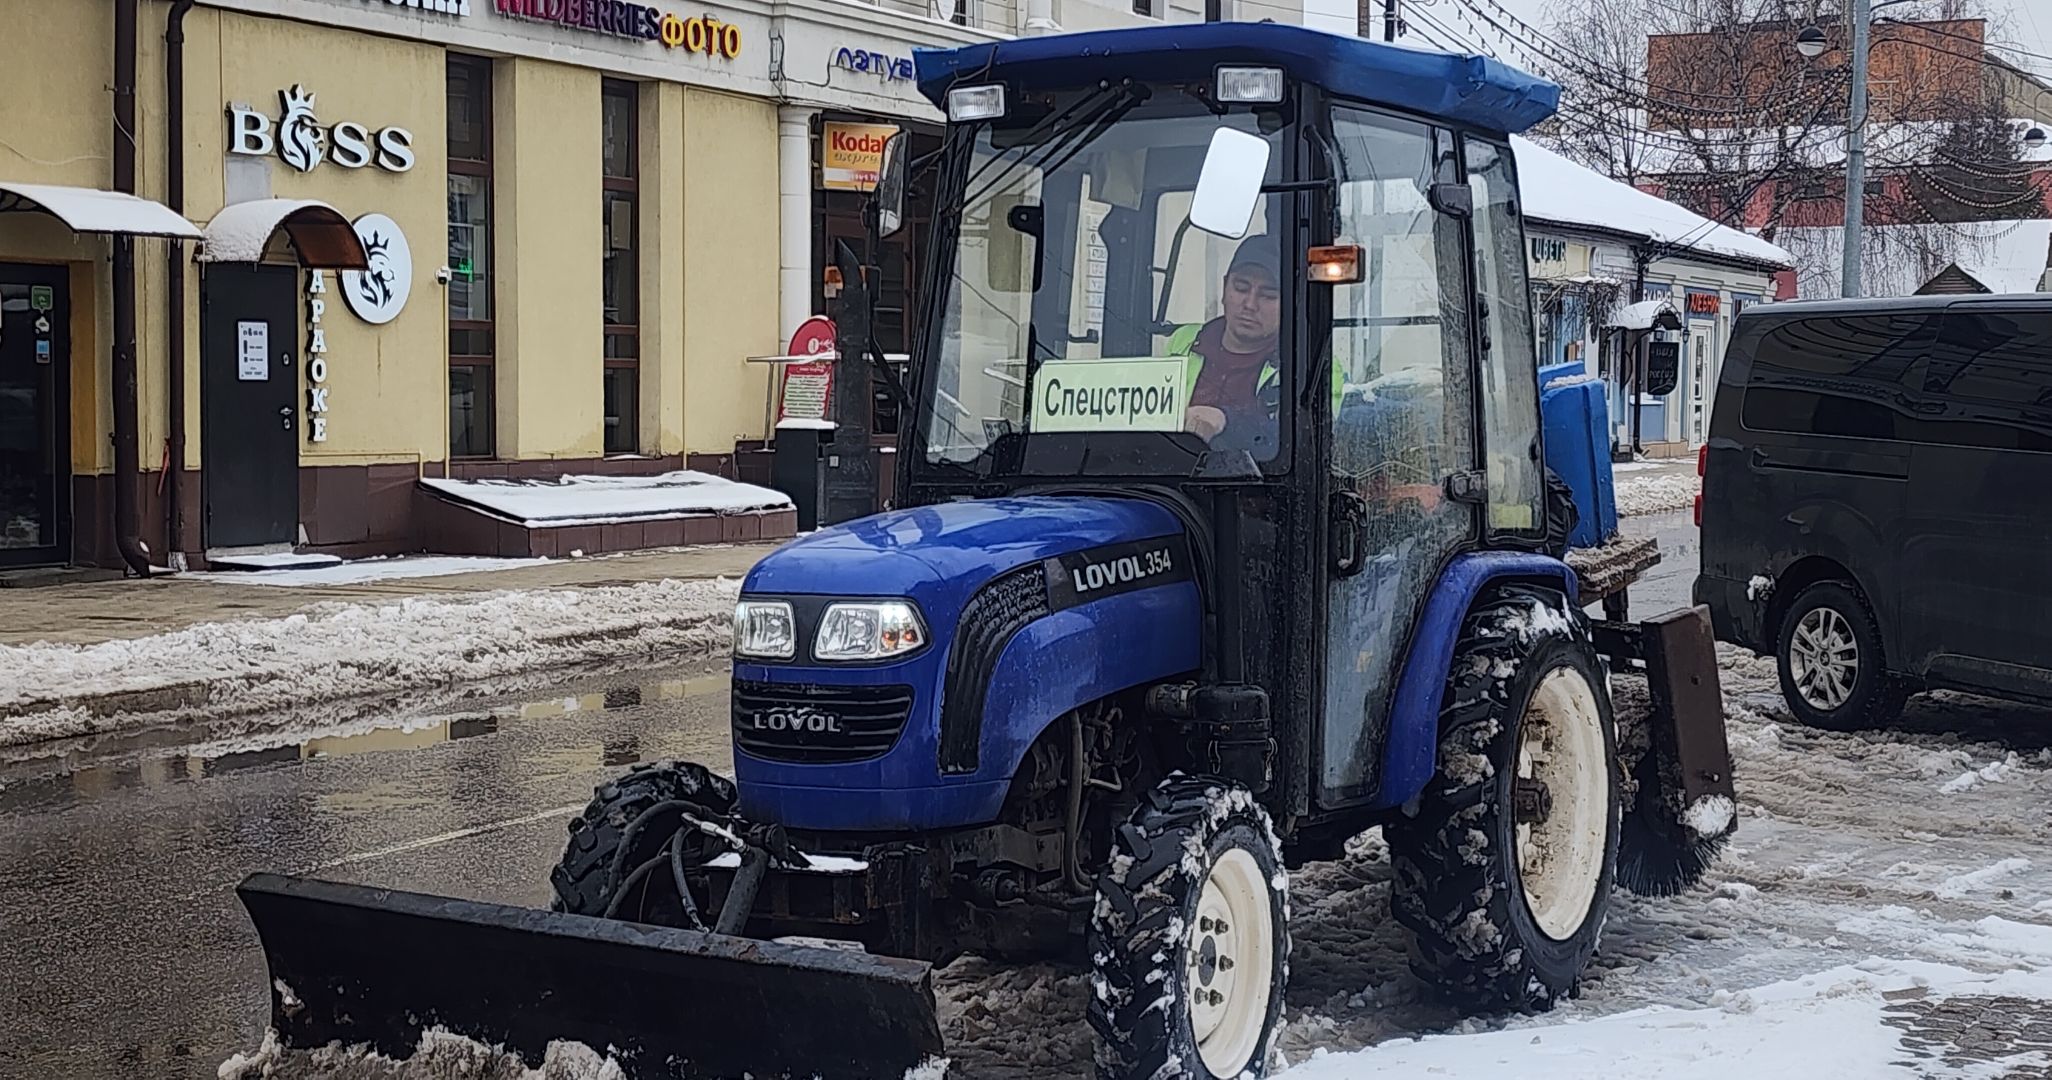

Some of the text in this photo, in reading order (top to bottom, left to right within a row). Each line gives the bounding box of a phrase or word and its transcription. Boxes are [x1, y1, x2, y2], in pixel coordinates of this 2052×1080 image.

[661, 14, 742, 59] ФОТО
[1045, 375, 1174, 425] Спецстрой
[1073, 548, 1172, 592] LOVOL 354
[754, 713, 841, 732] LOVOL
